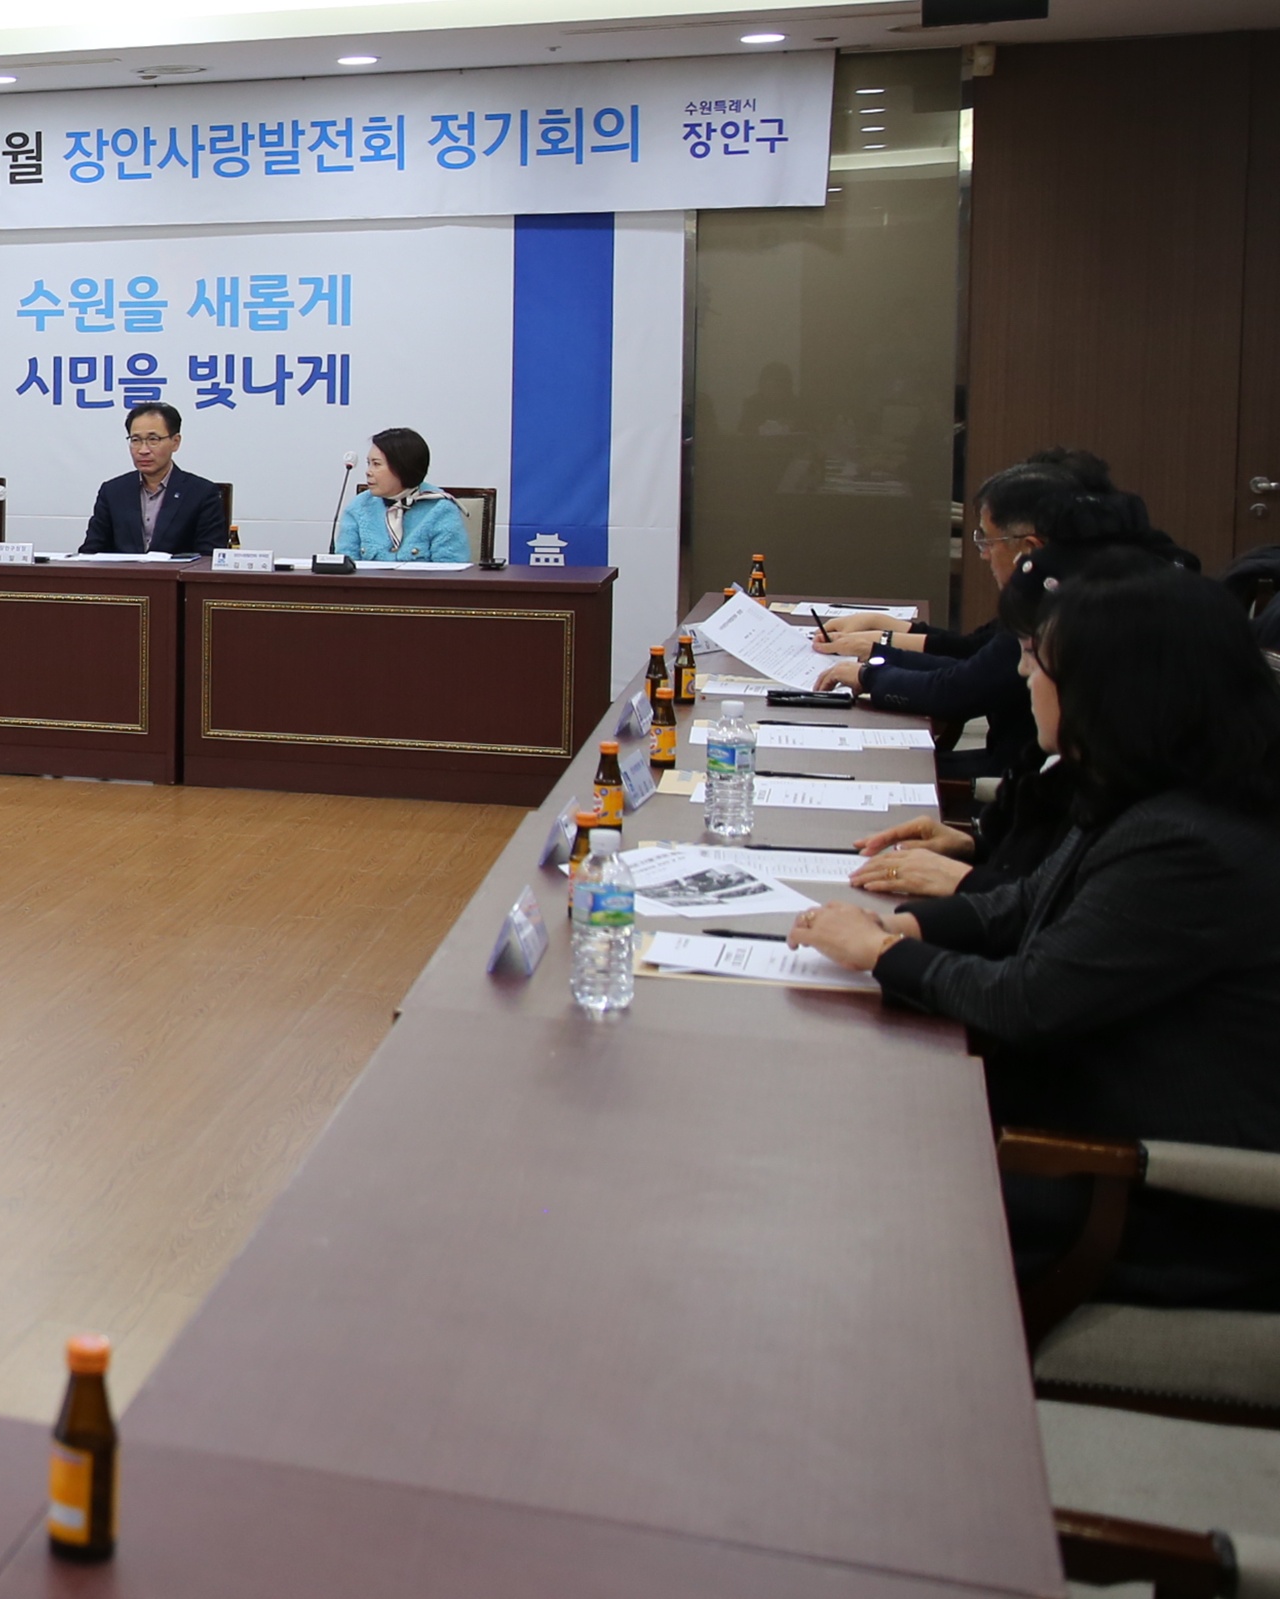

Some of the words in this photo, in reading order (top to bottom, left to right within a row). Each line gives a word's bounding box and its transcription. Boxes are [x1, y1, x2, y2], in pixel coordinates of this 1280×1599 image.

[683, 97, 758, 116] 수원특례시
[1, 130, 44, 185] 월
[62, 114, 406, 184] 장안사랑발전회
[427, 104, 640, 170] 정기회의
[682, 117, 789, 159] 장안구
[16, 275, 169, 333] 수원을
[186, 273, 352, 332] 새롭게
[15, 352, 168, 410] 시민을
[187, 353, 351, 411] 빛나게
